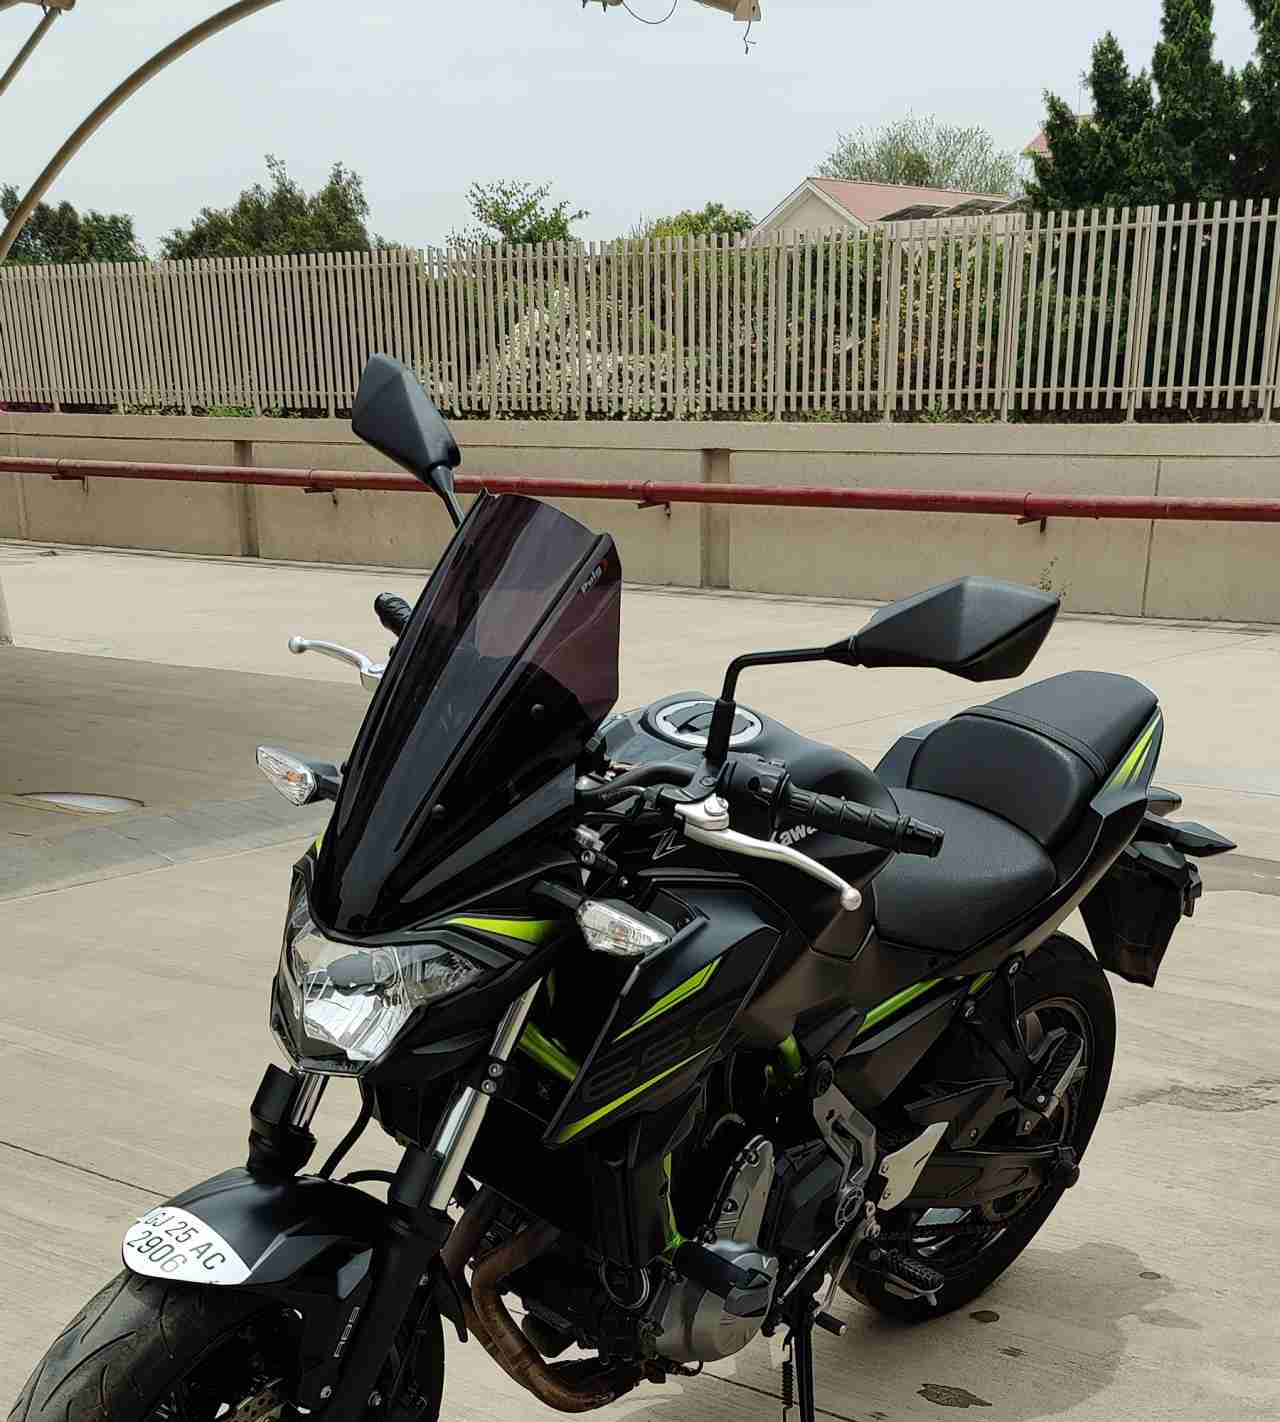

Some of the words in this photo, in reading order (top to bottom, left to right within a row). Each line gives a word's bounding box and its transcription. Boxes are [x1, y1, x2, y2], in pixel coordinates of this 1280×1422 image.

[126, 1229, 188, 1273] 2906
[165, 1220, 199, 1244] 25
[189, 1241, 227, 1271] AC
